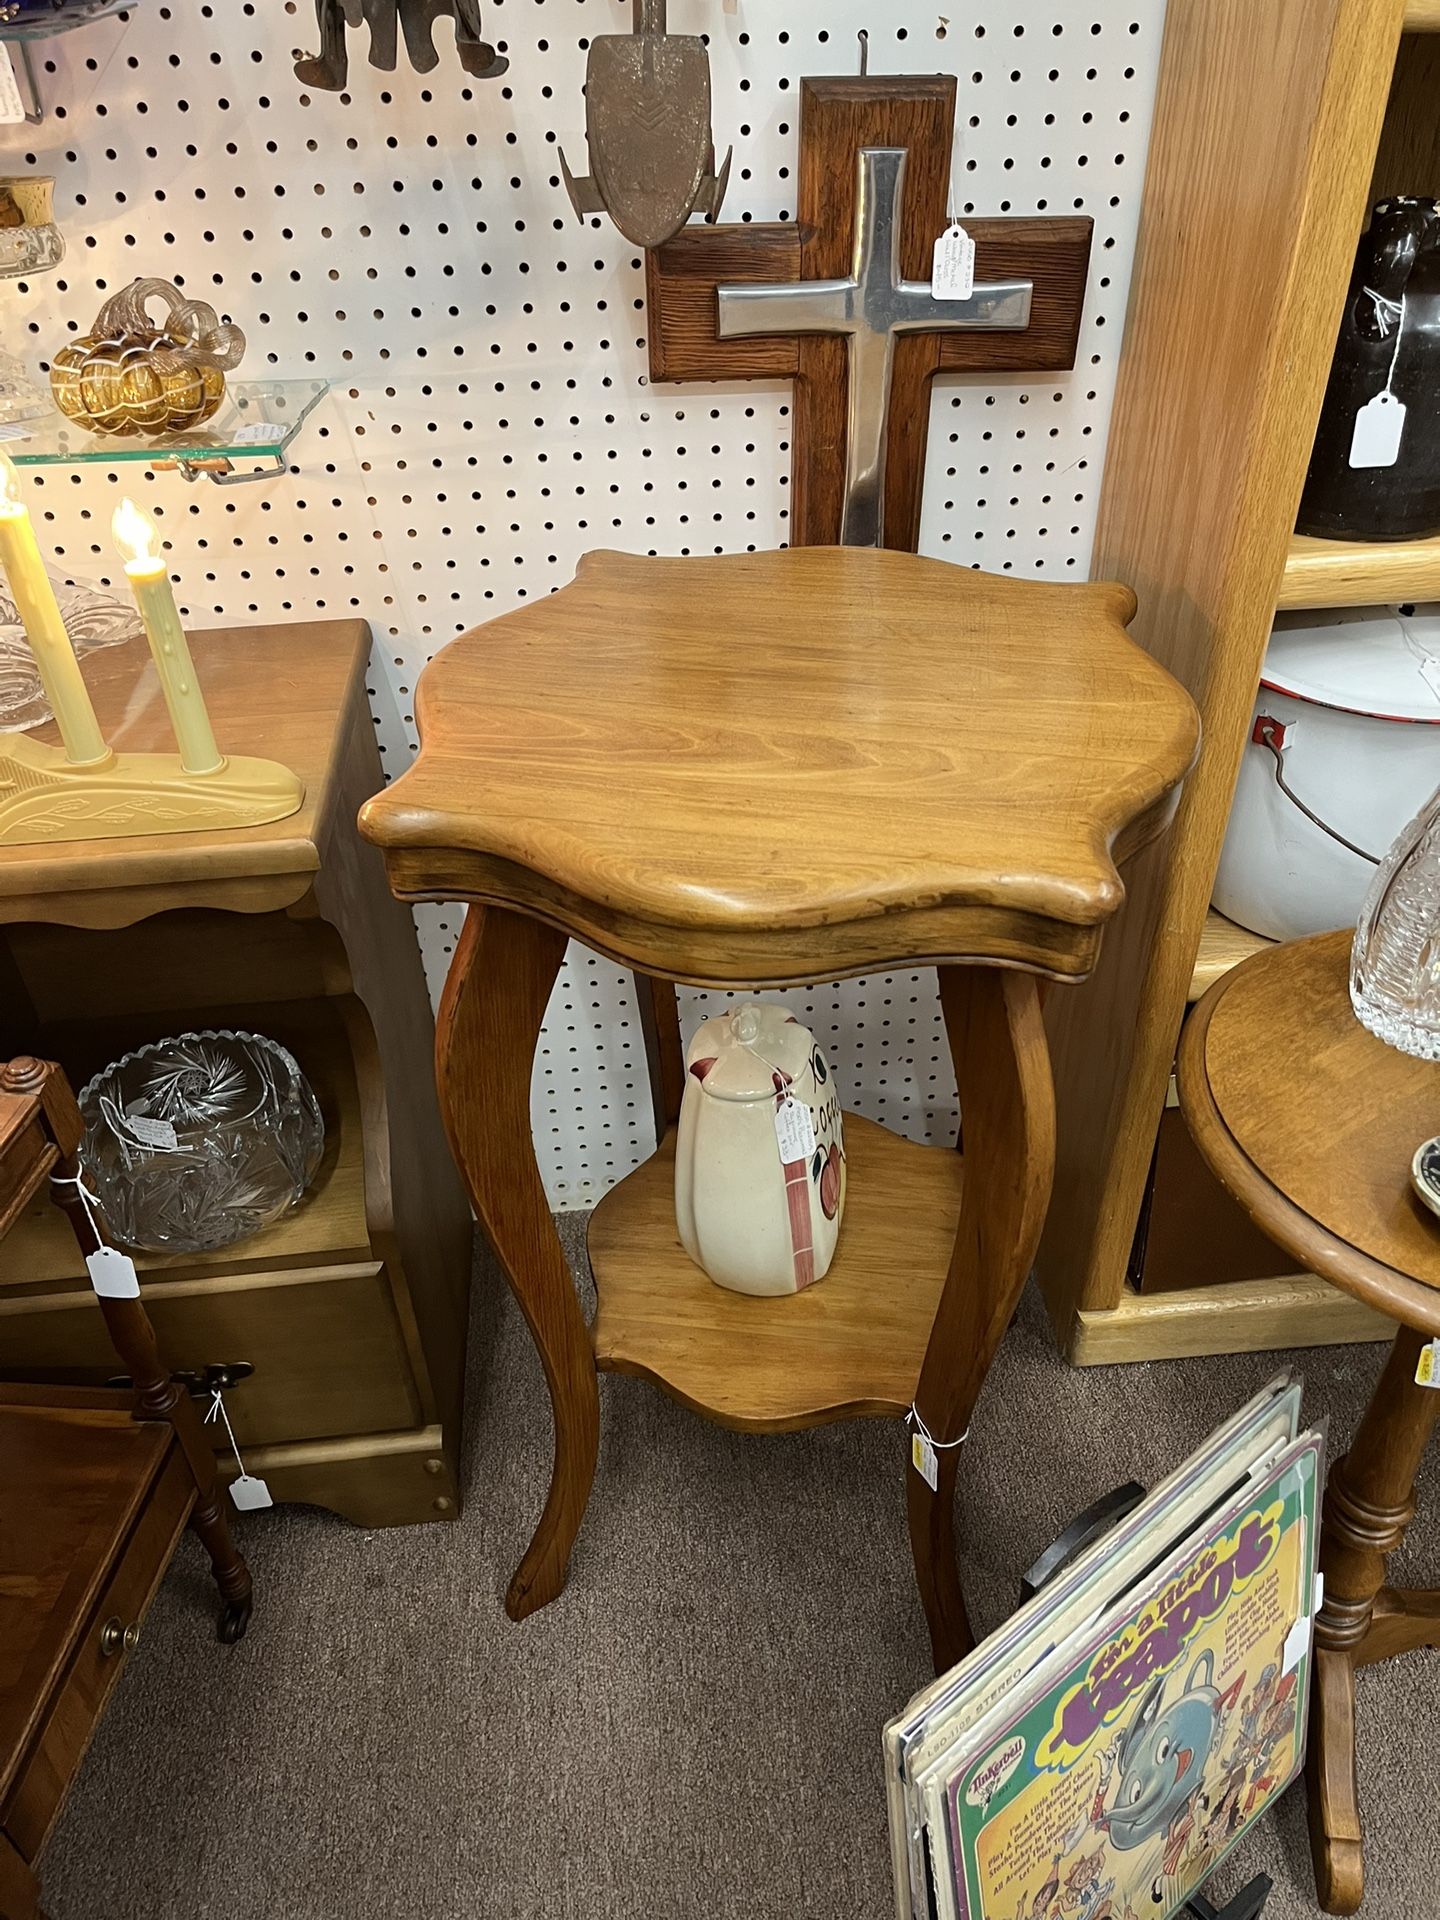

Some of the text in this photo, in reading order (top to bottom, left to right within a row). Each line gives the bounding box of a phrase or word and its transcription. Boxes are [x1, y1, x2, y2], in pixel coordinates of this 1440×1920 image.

[1137, 1614, 1154, 1636] a
[1157, 1550, 1217, 1620] little
[1049, 1516, 1274, 1753] teapot
[975, 1668, 1021, 1713] STEREO
[969, 1738, 1022, 1794] Tinkerbell
[1024, 1814, 1028, 1823] A
[1030, 1796, 1048, 1816] Little
[1059, 1795, 1071, 1808] The
[988, 1850, 1003, 1867] Play
[1007, 1842, 1011, 1850] A
[1014, 1821, 1033, 1843] Game
[1036, 1809, 1043, 1821] Of
[1009, 1799, 1077, 1868] Turkey In The Straw
[1037, 1847, 1051, 1862] Play
[994, 1881, 1003, 1895] All
[1006, 1854, 1030, 1883] Around
[1033, 1843, 1044, 1856] The
